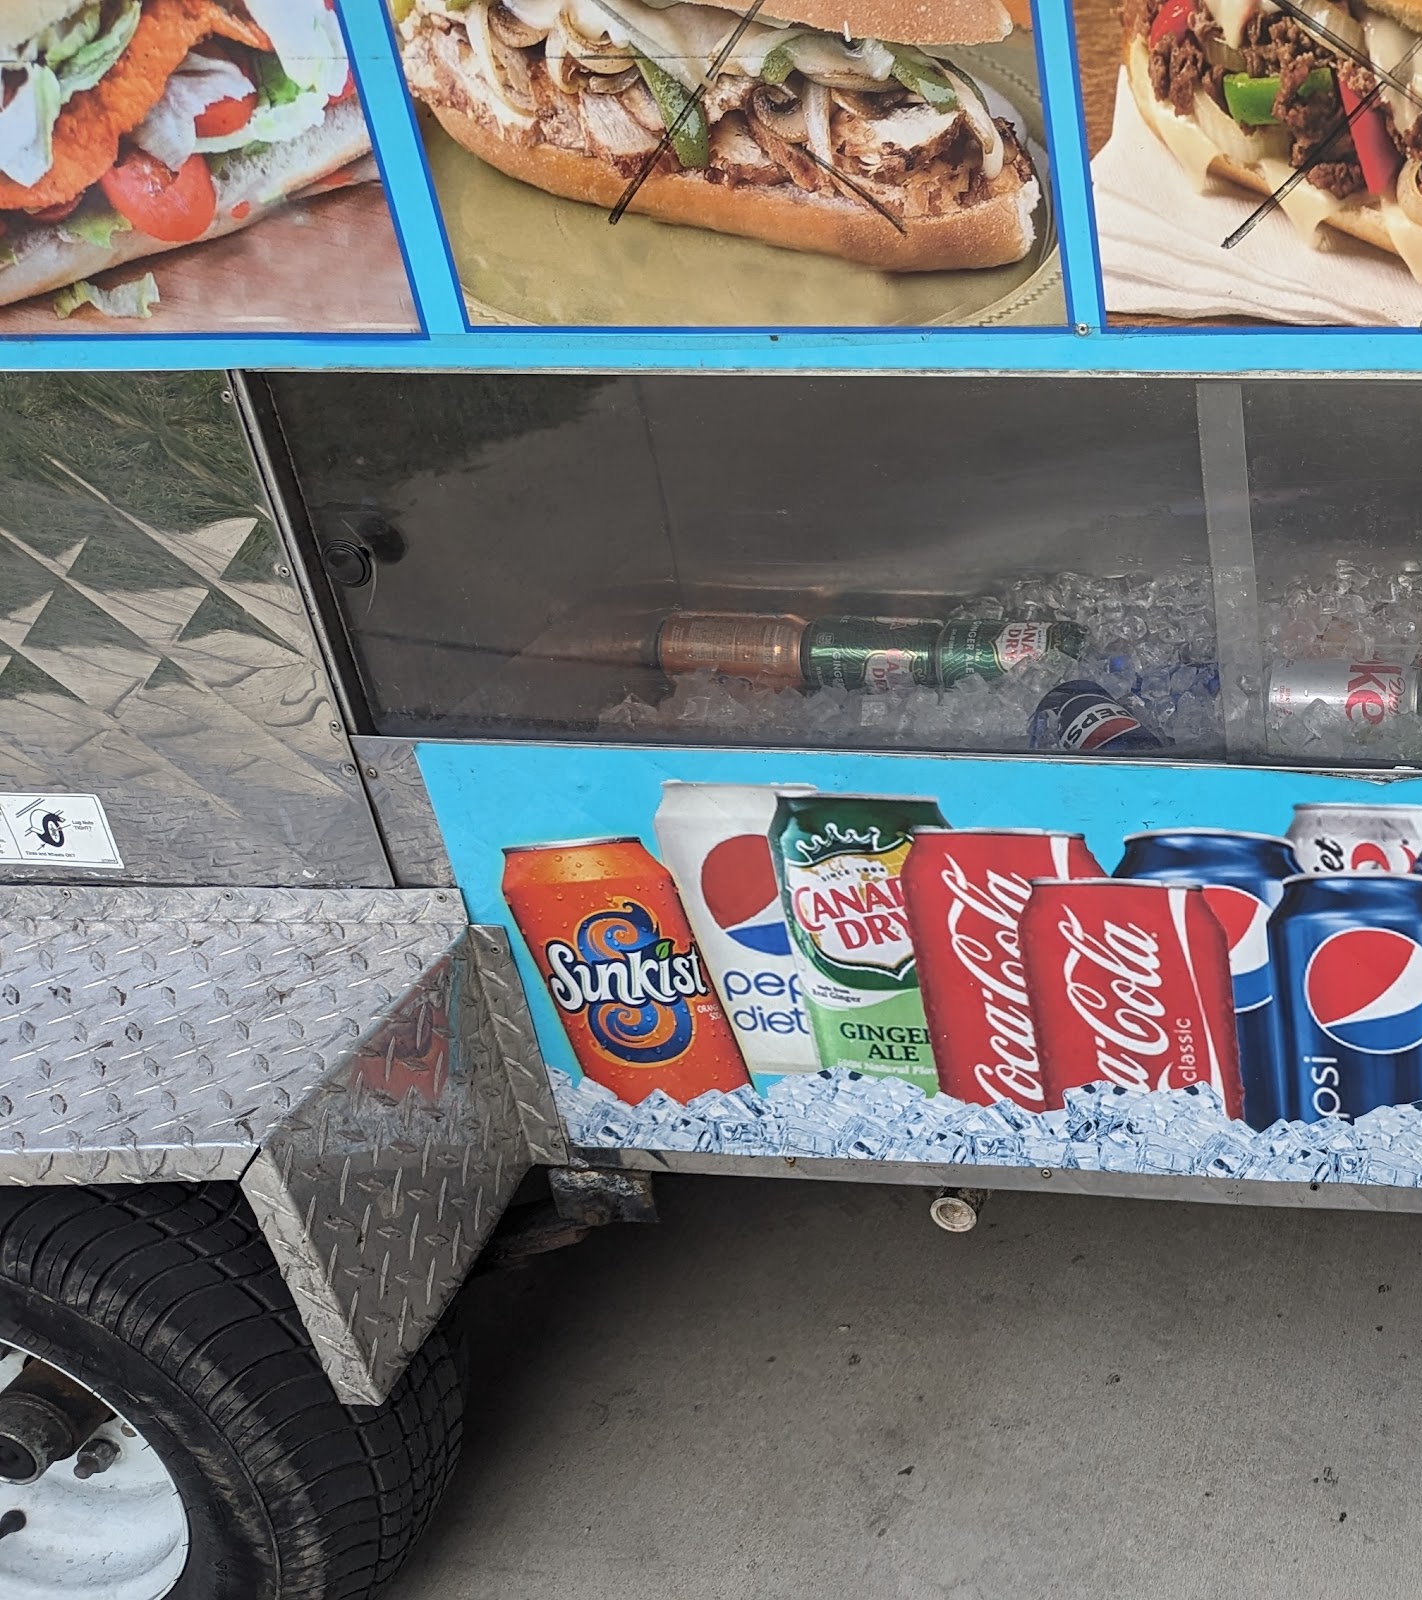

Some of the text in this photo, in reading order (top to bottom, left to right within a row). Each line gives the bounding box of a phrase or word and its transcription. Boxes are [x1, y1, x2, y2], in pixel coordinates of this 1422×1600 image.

[832, 650, 845, 689] GINGE
[965, 654, 975, 674] ALE
[550, 942, 708, 1012] Sunkist
[733, 1004, 811, 1034] diet
[868, 1044, 919, 1062] ALE
[1177, 1017, 1196, 1083] classic
